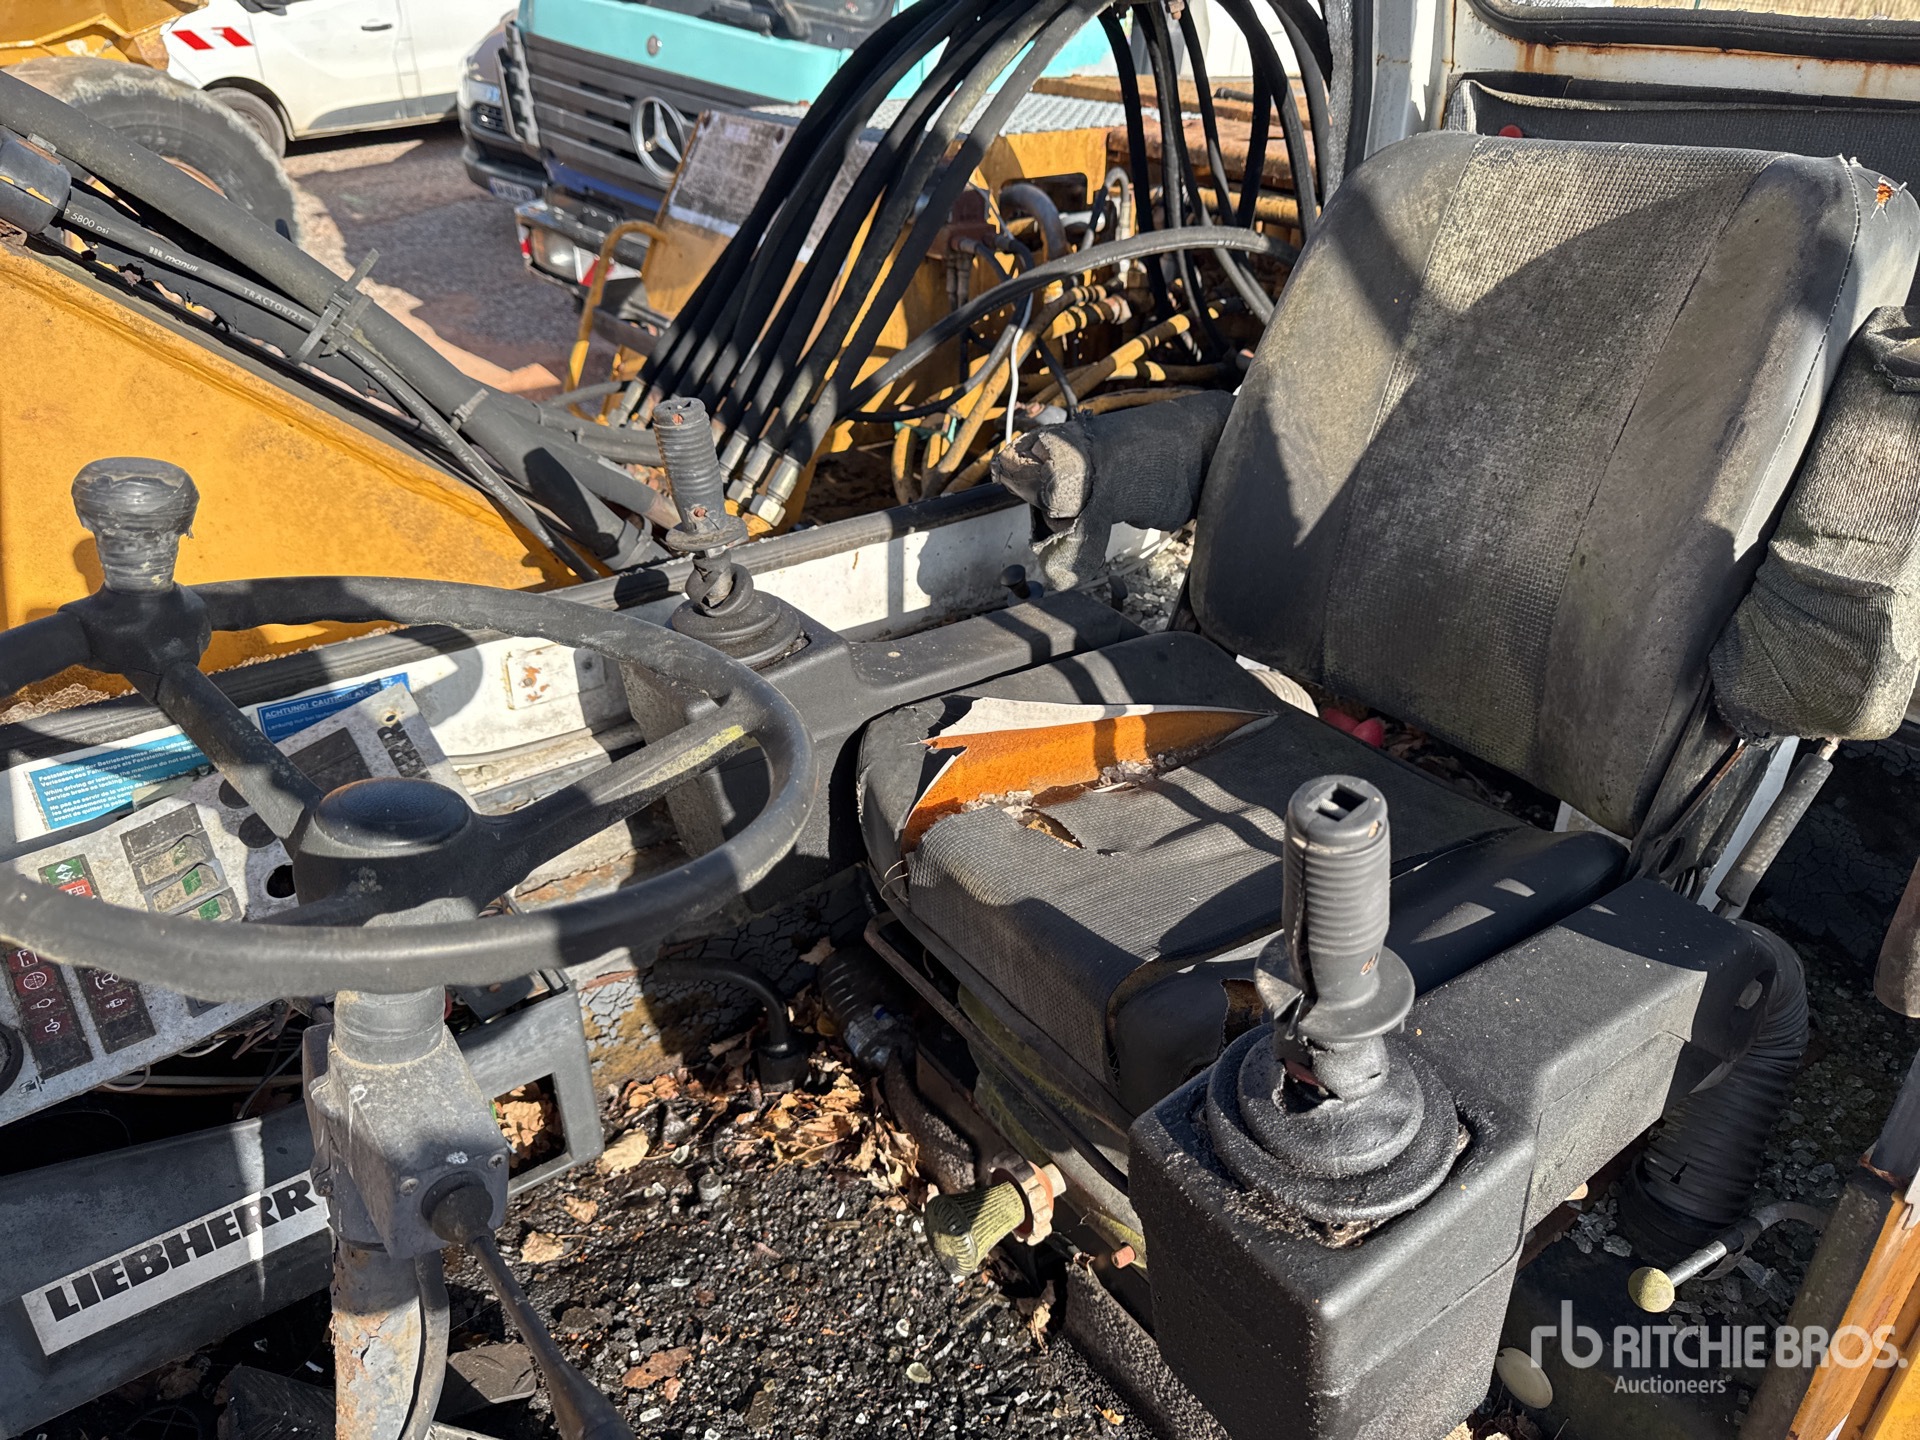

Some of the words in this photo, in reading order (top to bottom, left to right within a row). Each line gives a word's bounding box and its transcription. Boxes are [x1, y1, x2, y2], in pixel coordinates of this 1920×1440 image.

[70, 212, 95, 228] 5800
[243, 287, 304, 323] TRACTOR/2T
[265, 703, 309, 719] ACHTUNG!
[312, 691, 353, 708] CAUTION!
[44, 788, 63, 796] While
[64, 781, 87, 791] driving
[131, 763, 158, 774] machine
[44, 1178, 318, 1322] LIEBHERR
